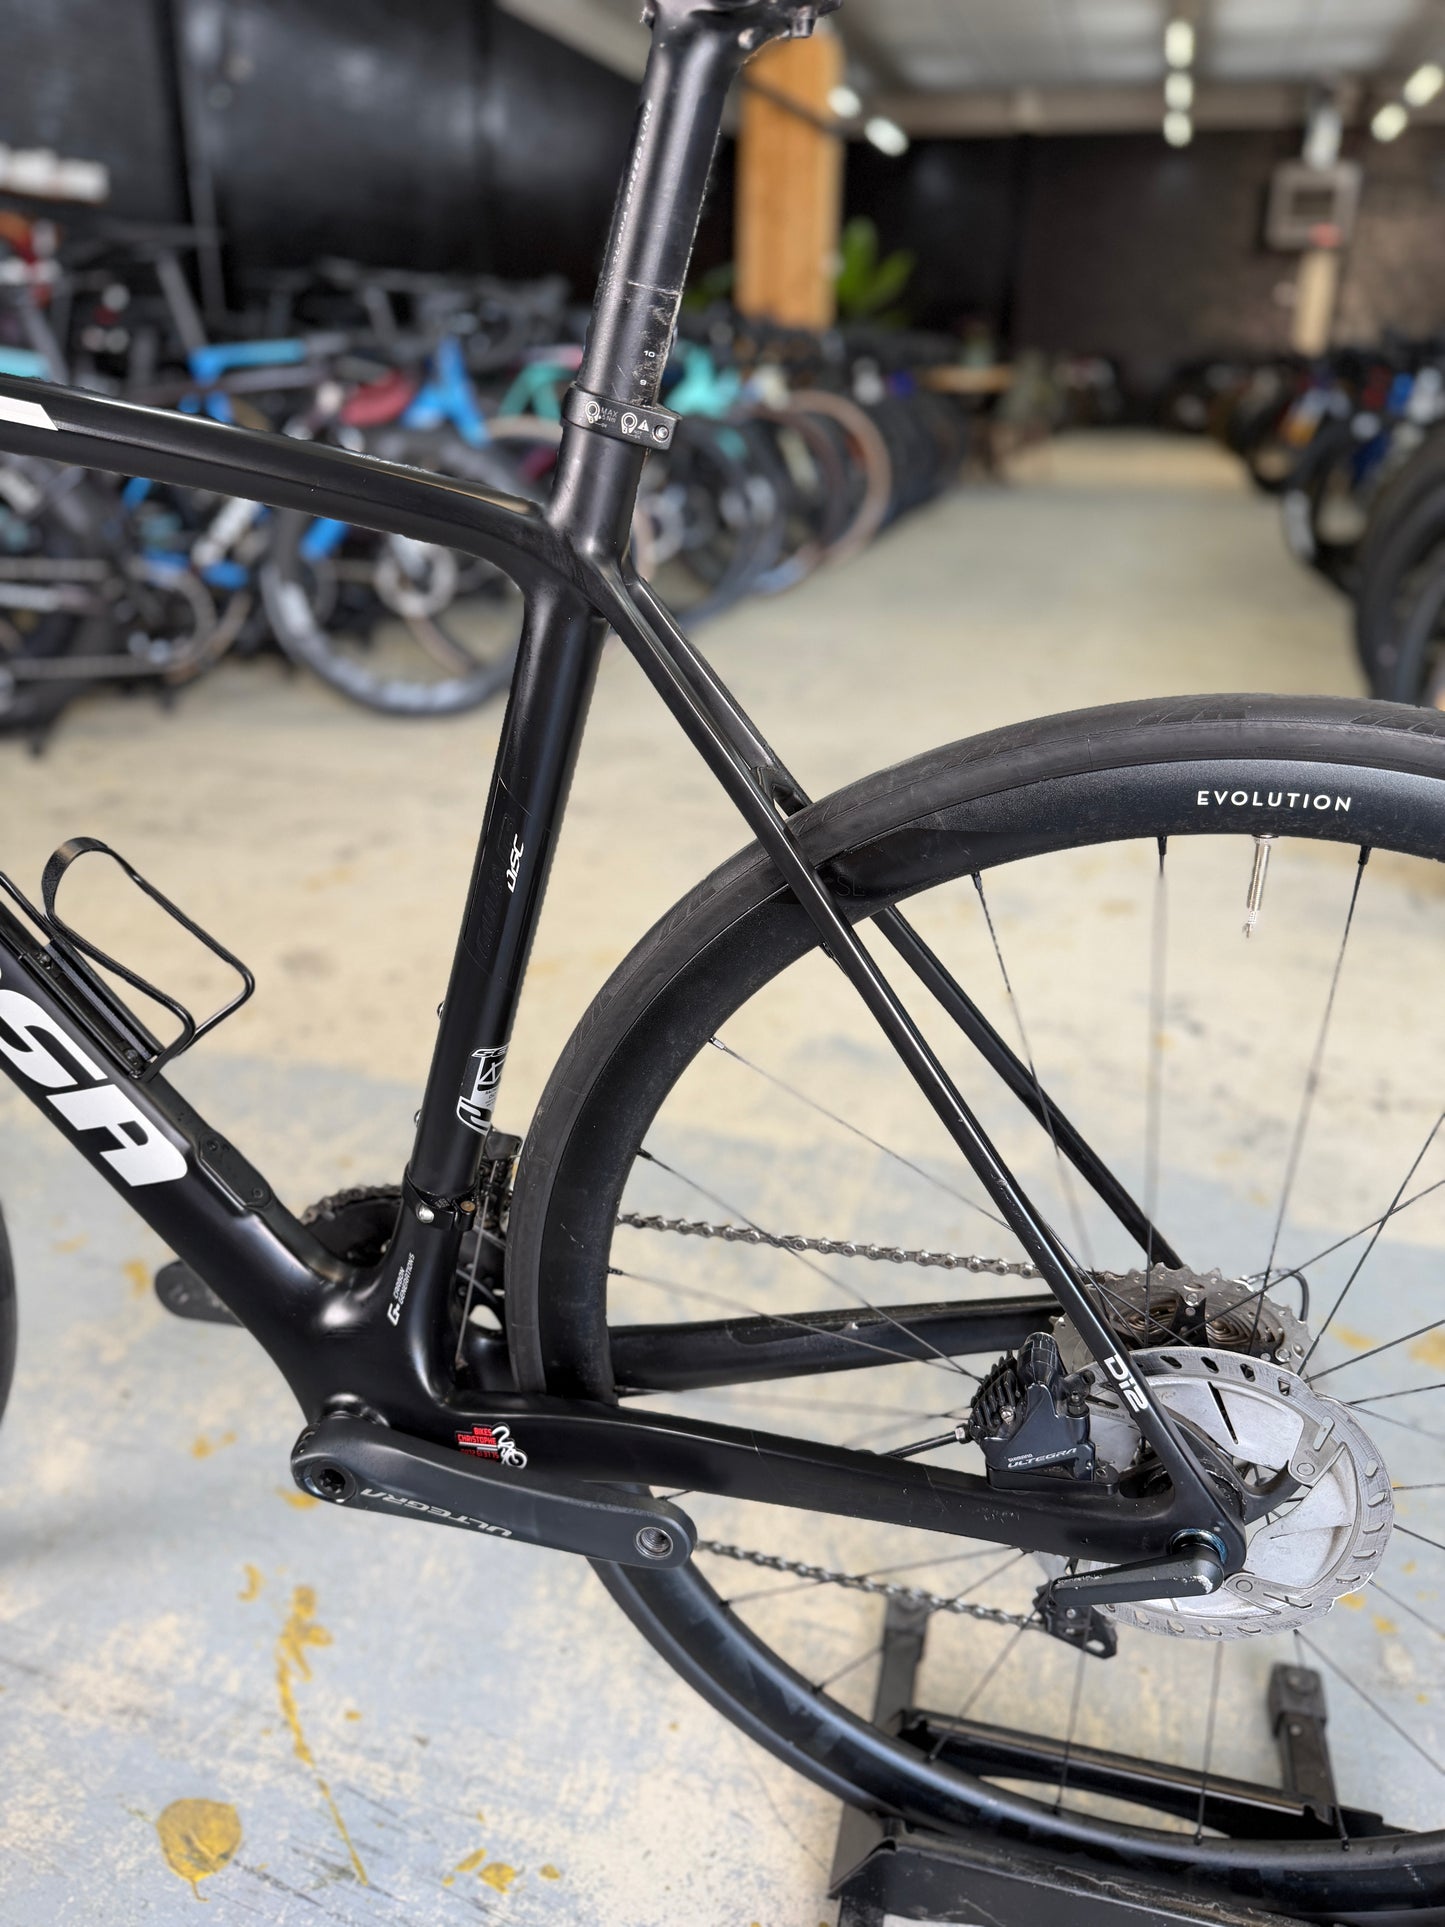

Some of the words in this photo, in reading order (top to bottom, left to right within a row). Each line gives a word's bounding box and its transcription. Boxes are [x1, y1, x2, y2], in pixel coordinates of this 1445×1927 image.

[643, 350, 656, 358] 10
[600, 407, 618, 419] MAX
[1196, 790, 1353, 812] EVOLUTION
[0, 966, 188, 1187] SA
[398, 1252, 415, 1306] GENERATIONS
[1103, 1354, 1148, 1413] Di2
[457, 1434, 497, 1445] CHRISTOPHE
[473, 1427, 492, 1436] BIKES
[1007, 1447, 1078, 1469] ULTEGRA
[360, 1488, 513, 1537] ULTEGRA
